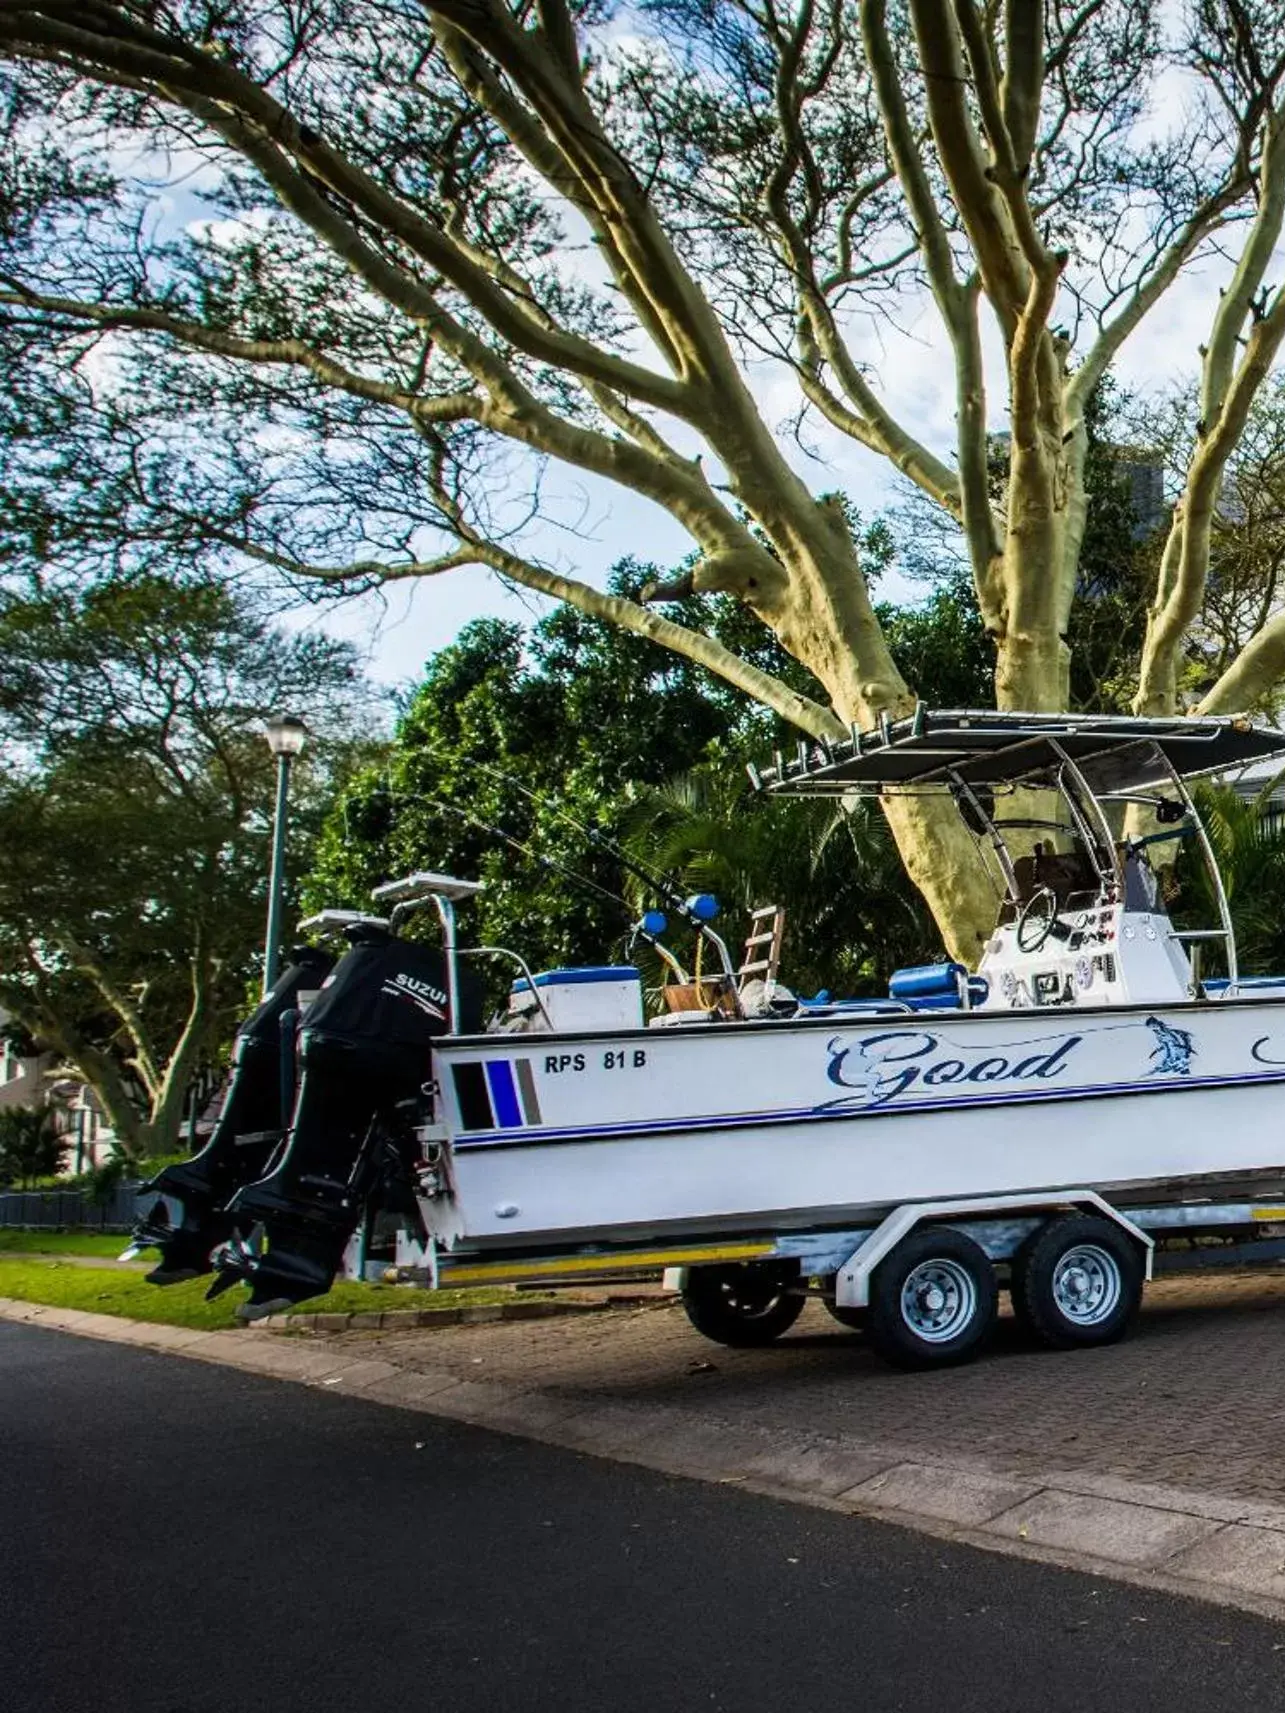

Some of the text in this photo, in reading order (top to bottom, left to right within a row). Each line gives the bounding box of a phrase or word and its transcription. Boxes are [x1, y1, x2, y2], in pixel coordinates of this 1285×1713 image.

[395, 973, 448, 1005] SUZU
[544, 1050, 647, 1074] RPS 81 B
[811, 1031, 1083, 1112] Good
